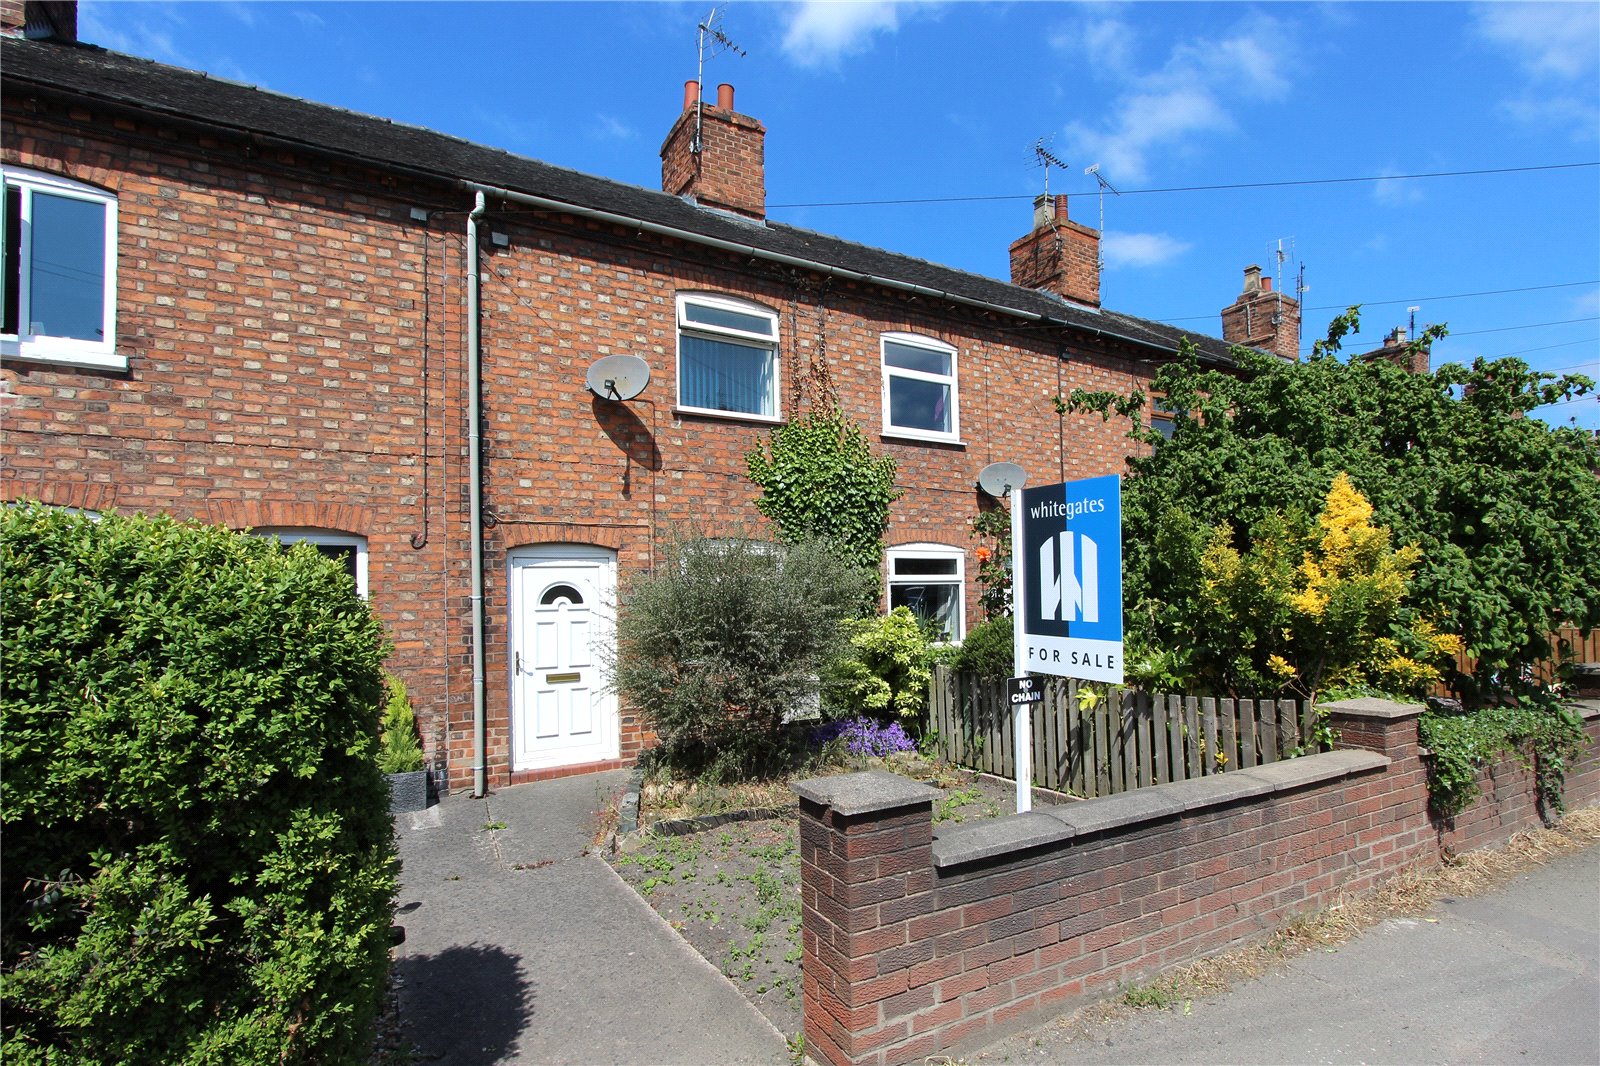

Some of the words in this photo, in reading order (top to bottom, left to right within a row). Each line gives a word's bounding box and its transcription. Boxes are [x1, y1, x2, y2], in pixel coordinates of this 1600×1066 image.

[1030, 498, 1105, 520] whitegates
[1029, 647, 1061, 663] FOR
[1071, 651, 1115, 669] SALE
[1019, 679, 1033, 689] NO
[1011, 691, 1041, 703] CHAIN
